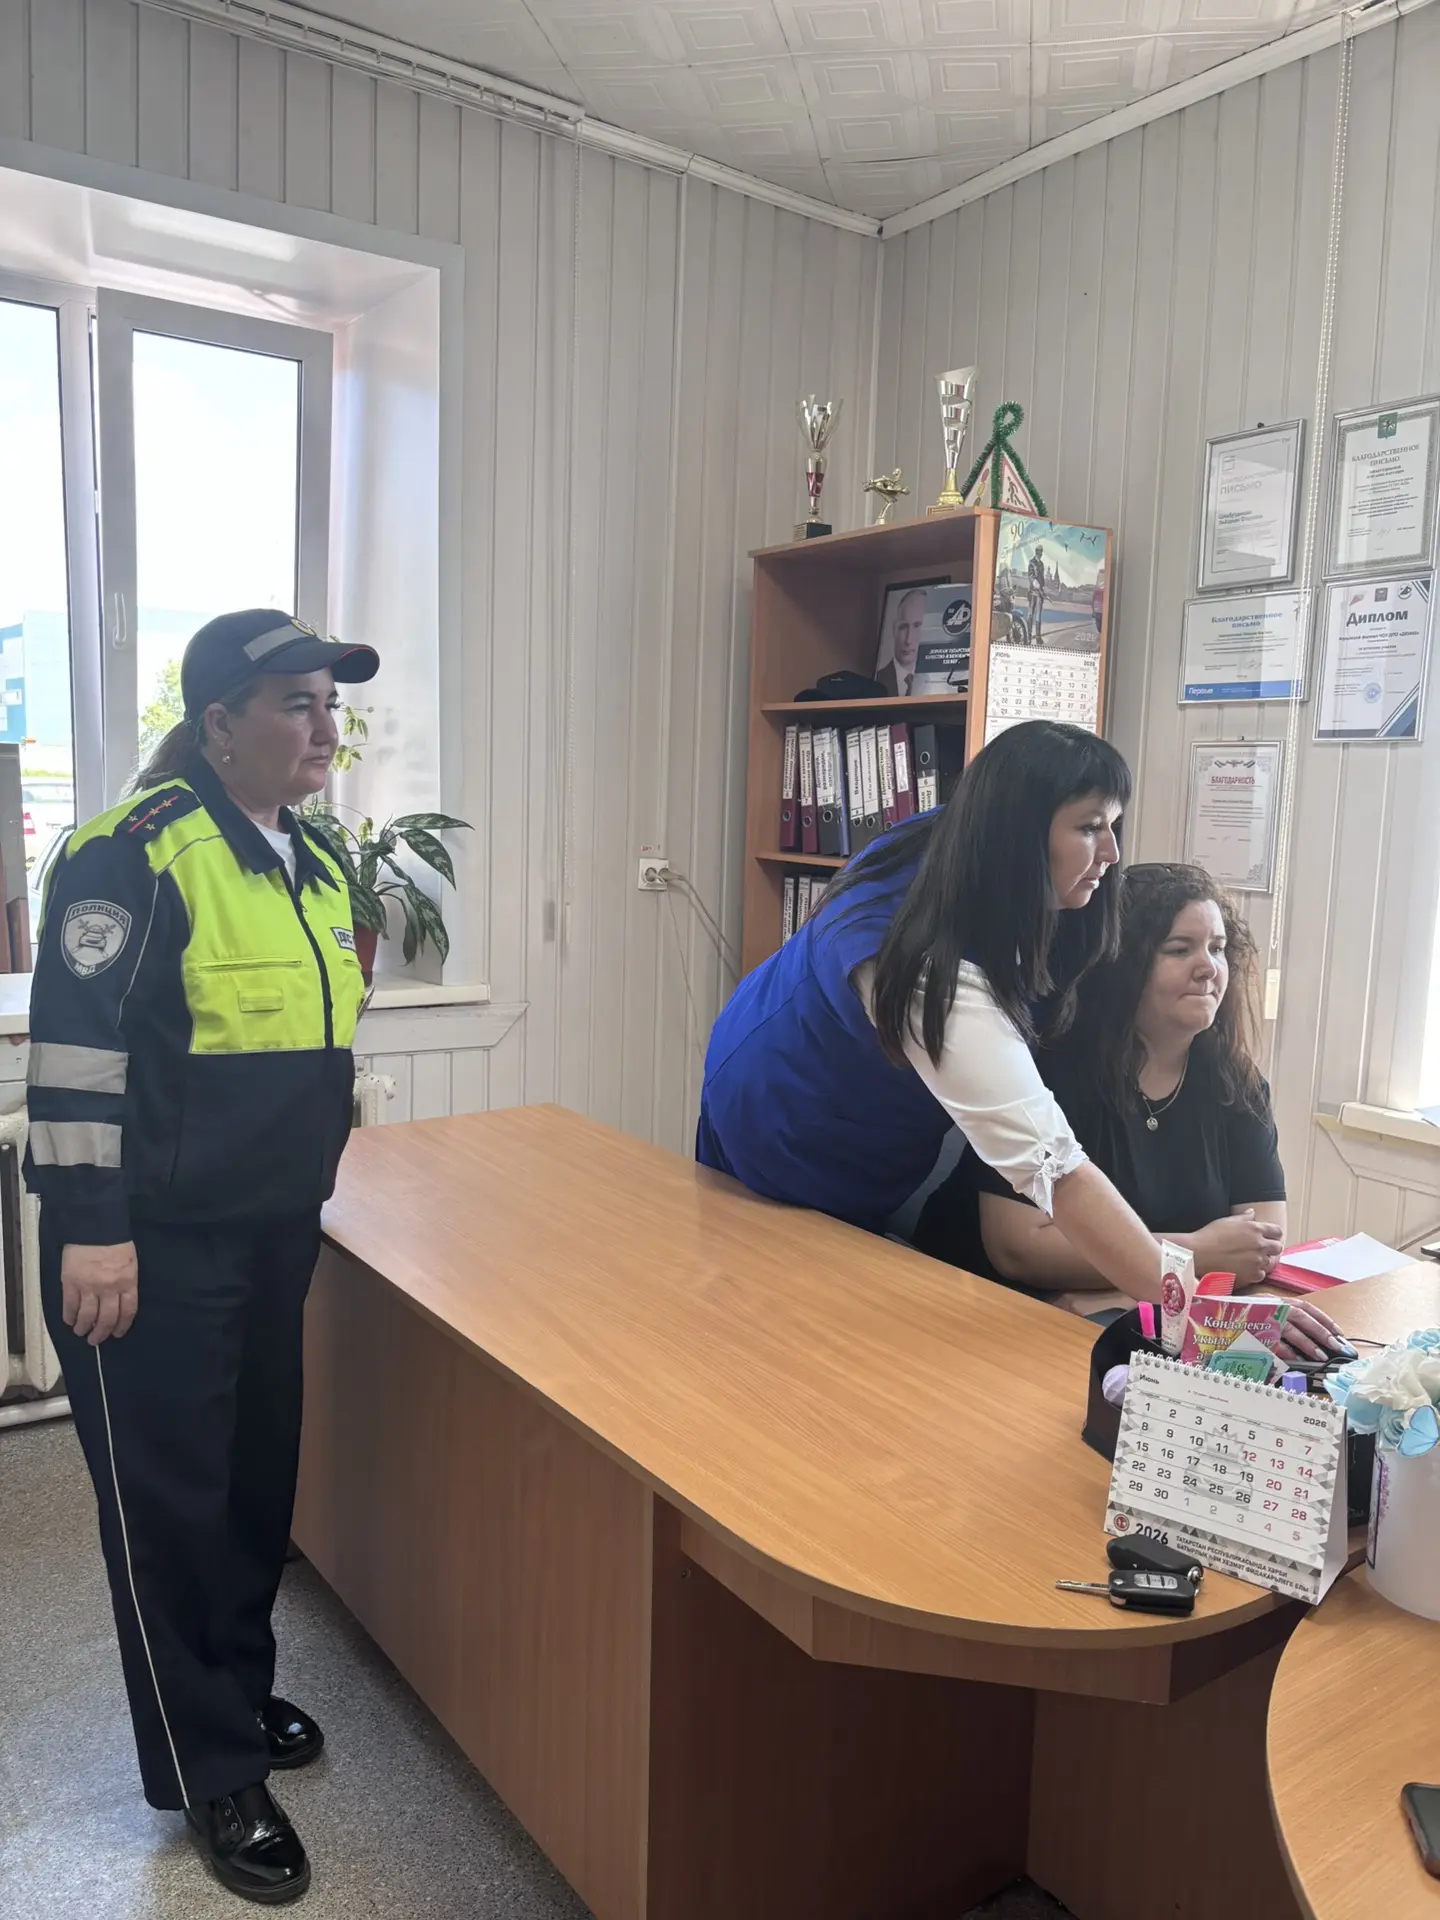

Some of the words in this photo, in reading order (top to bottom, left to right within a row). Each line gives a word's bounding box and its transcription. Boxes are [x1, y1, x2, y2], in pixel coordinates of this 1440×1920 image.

[1346, 610, 1408, 627] Диплом
[1211, 776, 1255, 784] БЛАГОДАРНОСТЬ
[72, 905, 125, 925] ПОЛИЦИЯ
[74, 962, 96, 975] МВД
[1204, 1316, 1272, 1330] Көндәлектә
[1139, 1373, 1160, 1385] Июнь
[1303, 1416, 1327, 1428] 2026
[1141, 1422, 1149, 1431] 8
[1166, 1429, 1174, 1438] 9
[1189, 1436, 1204, 1446] 10
[1216, 1443, 1229, 1454] 11
[1242, 1451, 1257, 1462] 12
[1270, 1458, 1285, 1470] 13
[1298, 1466, 1313, 1477] 14
[1145, 1402, 1151, 1411] 1
[1170, 1409, 1177, 1418] 2
[1195, 1416, 1203, 1425] 3
[1221, 1424, 1229, 1433] 4
[1248, 1431, 1255, 1440] 5
[1276, 1438, 1283, 1448] 6
[1304, 1446, 1312, 1455] 7
[1132, 1461, 1146, 1471] 22
[1157, 1468, 1171, 1479] 23
[1183, 1476, 1197, 1487] 24
[1209, 1483, 1223, 1495] 25
[1235, 1492, 1251, 1503] 26
[1263, 1500, 1279, 1511] 27
[1291, 1509, 1307, 1520] 28
[1136, 1441, 1149, 1451] 15
[1161, 1448, 1174, 1459] 16
[1186, 1455, 1200, 1466] 17
[1213, 1463, 1227, 1474] 18
[1240, 1471, 1254, 1482] 19
[1266, 1479, 1282, 1491] 20
[1294, 1487, 1308, 1499] 21
[1129, 1480, 1143, 1492] 29
[1154, 1488, 1169, 1500] 30
[1184, 1497, 1190, 1506] 1
[1210, 1505, 1217, 1515] 2
[1237, 1514, 1244, 1523] 3
[1264, 1523, 1272, 1532] 4
[1292, 1531, 1300, 1541] 5
[1176, 1535, 1206, 1550] ТАТАРСТАН
[1207, 1546, 1267, 1570] РЕСПУБЛИКАСЫНДА
[1268, 1566, 1288, 1578] ХӘРБИ
[1177, 1543, 1207, 1558] БАТЫРЛЫК
[1222, 1559, 1245, 1571] ХЕЗМӘТ
[1245, 1566, 1293, 1587] ФИДАКАРЬЛЕГЕ
[1295, 1583, 1309, 1592] ЕЛЫ
